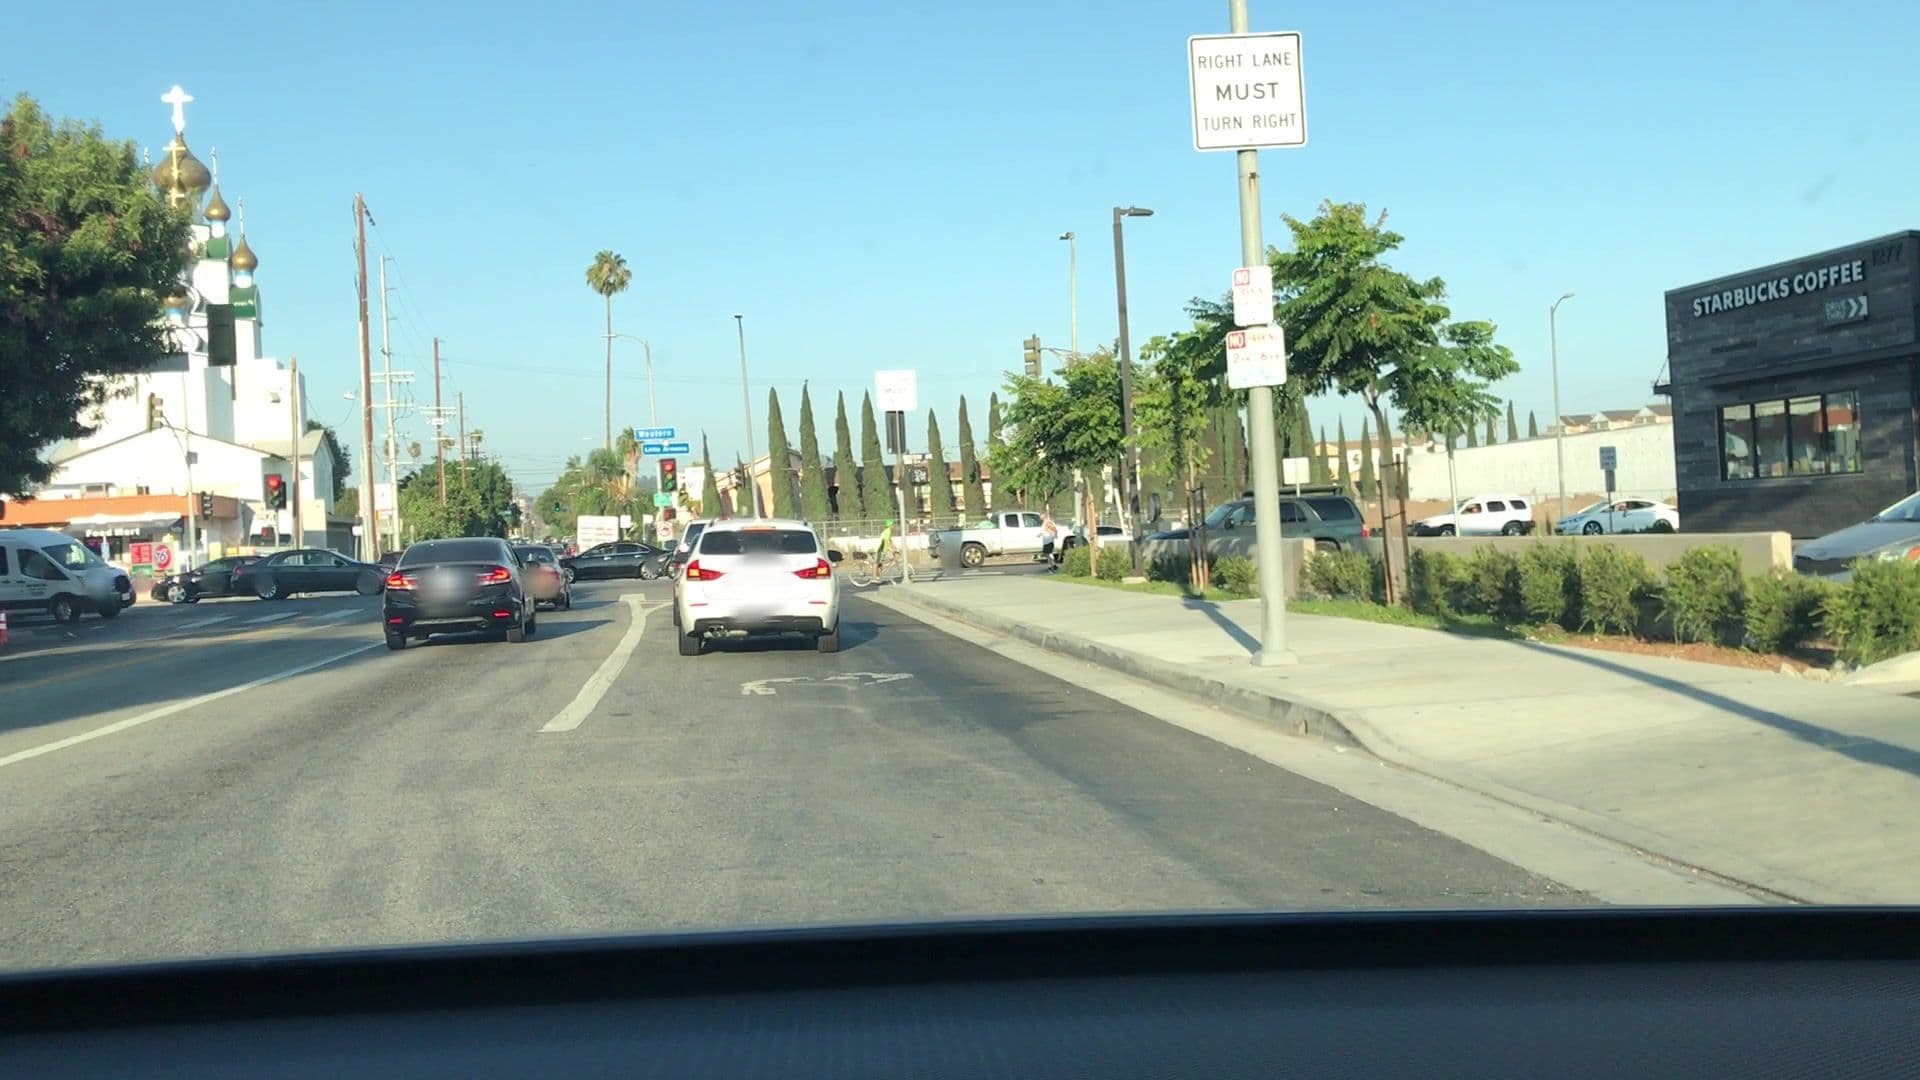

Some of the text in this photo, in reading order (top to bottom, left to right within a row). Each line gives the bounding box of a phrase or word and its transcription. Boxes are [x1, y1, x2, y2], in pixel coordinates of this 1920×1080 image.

[1198, 51, 1292, 69] RIGHT LANE
[1215, 82, 1279, 101] MUST
[1203, 113, 1296, 132] TURN RIGHT
[1693, 259, 1863, 317] STARBUCKS COFFEE
[1229, 333, 1245, 349] NO
[86, 527, 140, 537] Food Mart
[154, 550, 169, 564] 76
